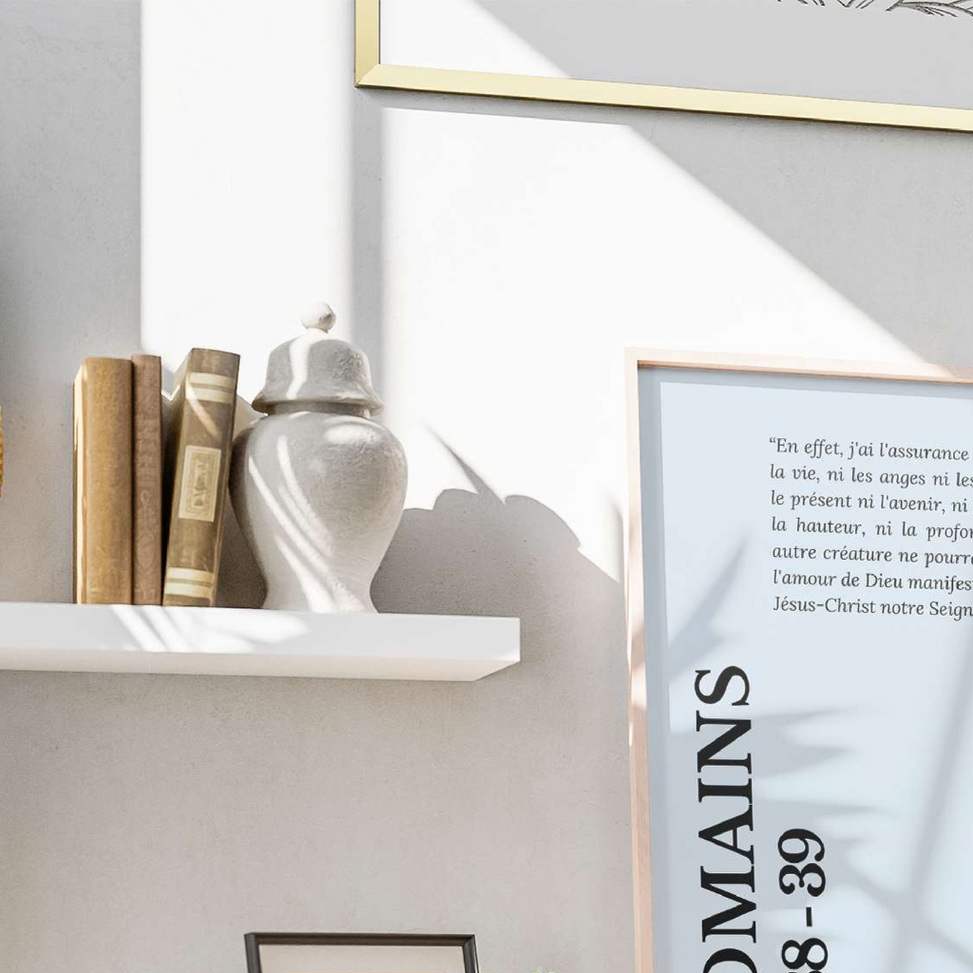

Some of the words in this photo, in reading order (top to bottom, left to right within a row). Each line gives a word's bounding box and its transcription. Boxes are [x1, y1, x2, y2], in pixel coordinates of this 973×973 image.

[768, 436, 800, 454] “En
[803, 438, 844, 460] effet,
[846, 441, 875, 461] j'ai
[879, 441, 970, 462] l'assurance
[769, 463, 786, 480] la
[791, 465, 821, 485] vie,
[826, 466, 845, 483] ni
[850, 466, 873, 484] les
[879, 472, 926, 490] anges
[931, 471, 951, 487] ni
[770, 489, 785, 506] le
[789, 491, 853, 511] présent
[856, 493, 876, 510] ni
[880, 493, 946, 516] l'avenir,
[950, 497, 969, 513] ni
[771, 515, 788, 532] la
[795, 516, 866, 538] hauteur,
[874, 520, 894, 537] ni
[901, 520, 919, 538] la
[772, 545, 817, 560] autre
[822, 544, 893, 563] créature
[897, 551, 919, 564] ne
[772, 568, 838, 587] l'amour
[840, 571, 861, 588] de
[864, 572, 904, 590] Dieu
[772, 595, 877, 614] Jésus-Christ
[879, 601, 925, 616] notre
